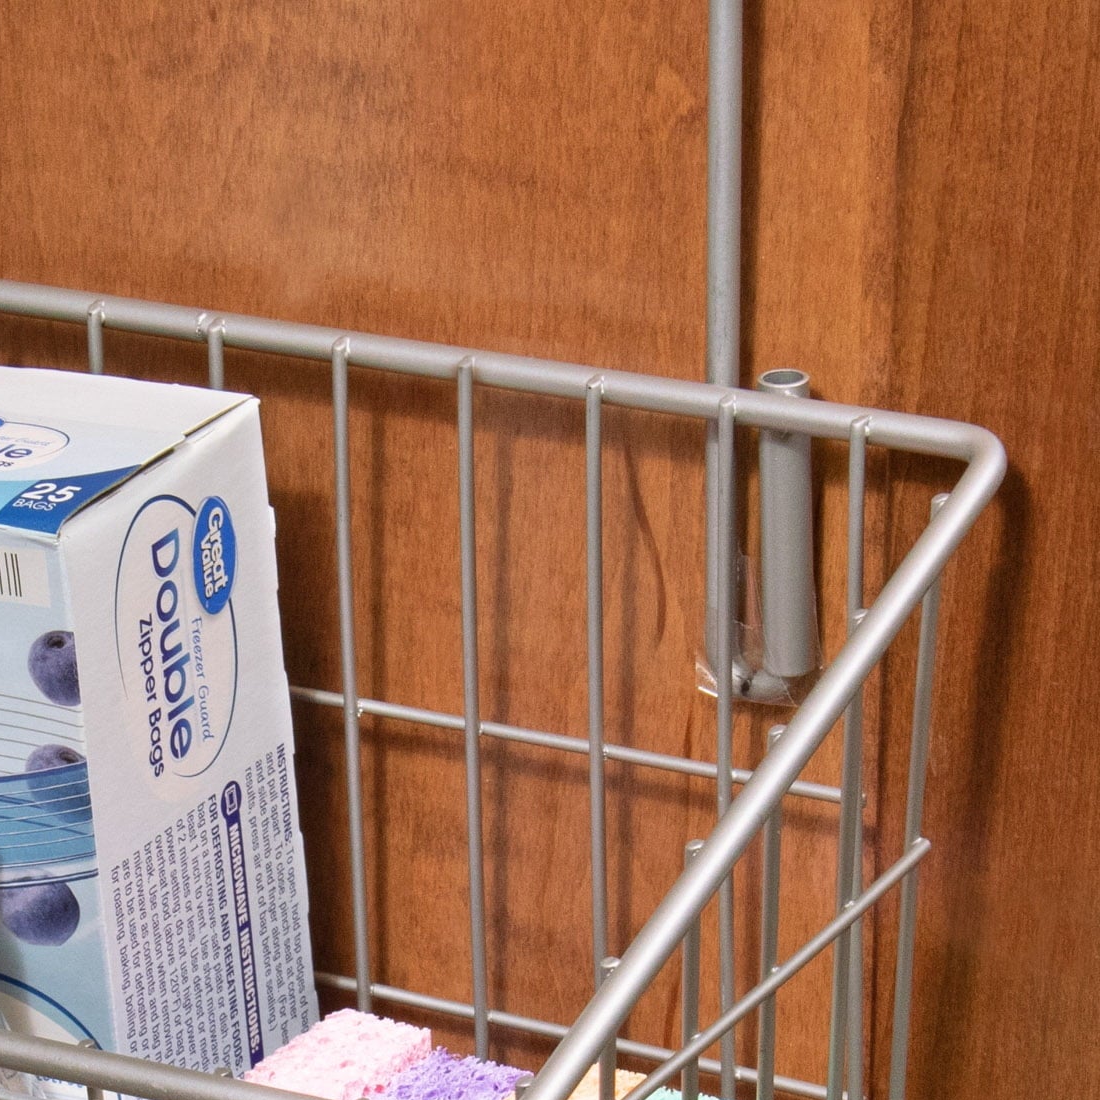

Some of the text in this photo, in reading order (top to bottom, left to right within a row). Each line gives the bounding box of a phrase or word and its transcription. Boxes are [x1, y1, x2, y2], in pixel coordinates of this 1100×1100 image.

[12, 498, 57, 512] BAGS
[22, 482, 82, 504] 25
[200, 538, 213, 599] Value
[208, 506, 228, 594] Great
[151, 527, 195, 760] Double
[138, 613, 165, 778] Zipper Bags
[191, 616, 215, 742] Freezer Guard
[257, 785, 268, 817] slide
[266, 778, 279, 803] pull
[186, 808, 198, 843] least
[248, 815, 260, 852] press
[261, 816, 273, 859] thumb
[154, 834, 169, 891] overheat
[164, 826, 176, 866] power
[253, 852, 262, 870] air
[179, 846, 191, 899] minutes
[191, 855, 202, 885] inch
[255, 872, 265, 894] out
[276, 743, 293, 846] INSTRUCTIONS:
[291, 902, 301, 932] hold
[296, 955, 306, 995] edges
[148, 884, 158, 911] Use
[161, 891, 172, 922] food
[197, 801, 206, 829] bag
[213, 962, 224, 995] plate
[268, 886, 278, 923] finger
[151, 912, 163, 961] caution
[207, 793, 244, 1071] FOR DEFROSTING AND REHEATING FOODS:
[258, 909, 268, 937] bag
[278, 901, 291, 937] pinch
[110, 865, 120, 884] for
[125, 993, 137, 1040] boiling
[122, 858, 148, 1038] are used for defrosting
[133, 850, 161, 1050] microwave contents and bag
[177, 937, 187, 961] not
[199, 934, 209, 961] Use
[229, 823, 260, 1055] MICROWAVE INSTRUCTIONS:
[261, 935, 272, 978] before
[271, 925, 281, 962] along
[283, 937, 294, 964] seal
[180, 961, 189, 985] use
[190, 946, 199, 973] Use
[156, 961, 167, 998] when
[202, 961, 214, 996] short
[182, 985, 193, 1016] high
[193, 975, 205, 1020] defrost
[287, 981, 298, 1020] corner
[160, 999, 174, 1060] removing
[175, 1028, 185, 1057] bag
[206, 996, 220, 1065] microwave
